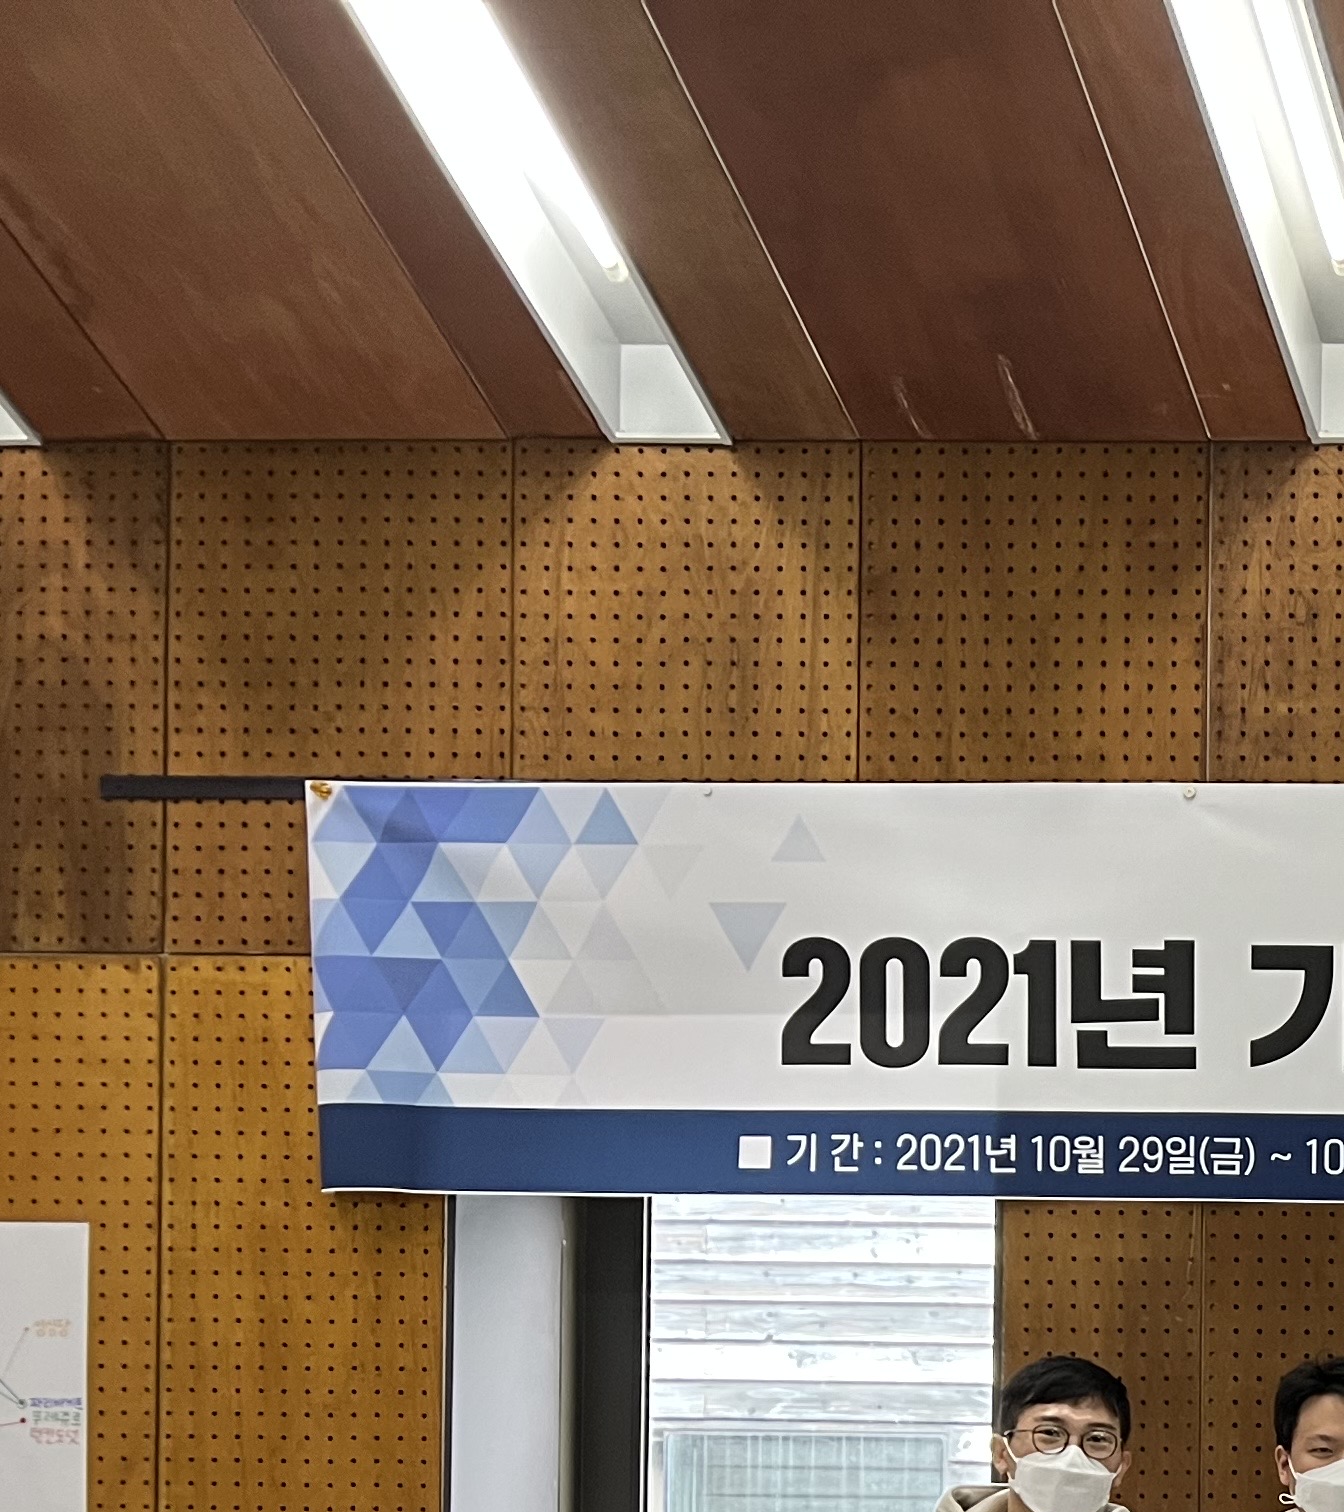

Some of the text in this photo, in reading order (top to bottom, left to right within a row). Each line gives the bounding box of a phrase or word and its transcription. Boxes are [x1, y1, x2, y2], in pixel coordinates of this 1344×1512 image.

[781, 936, 1197, 1070] 2021년
[896, 1133, 1017, 1174] 2021년
[1031, 1135, 1105, 1174] 10월
[1118, 1135, 1255, 1176] 29일(금)
